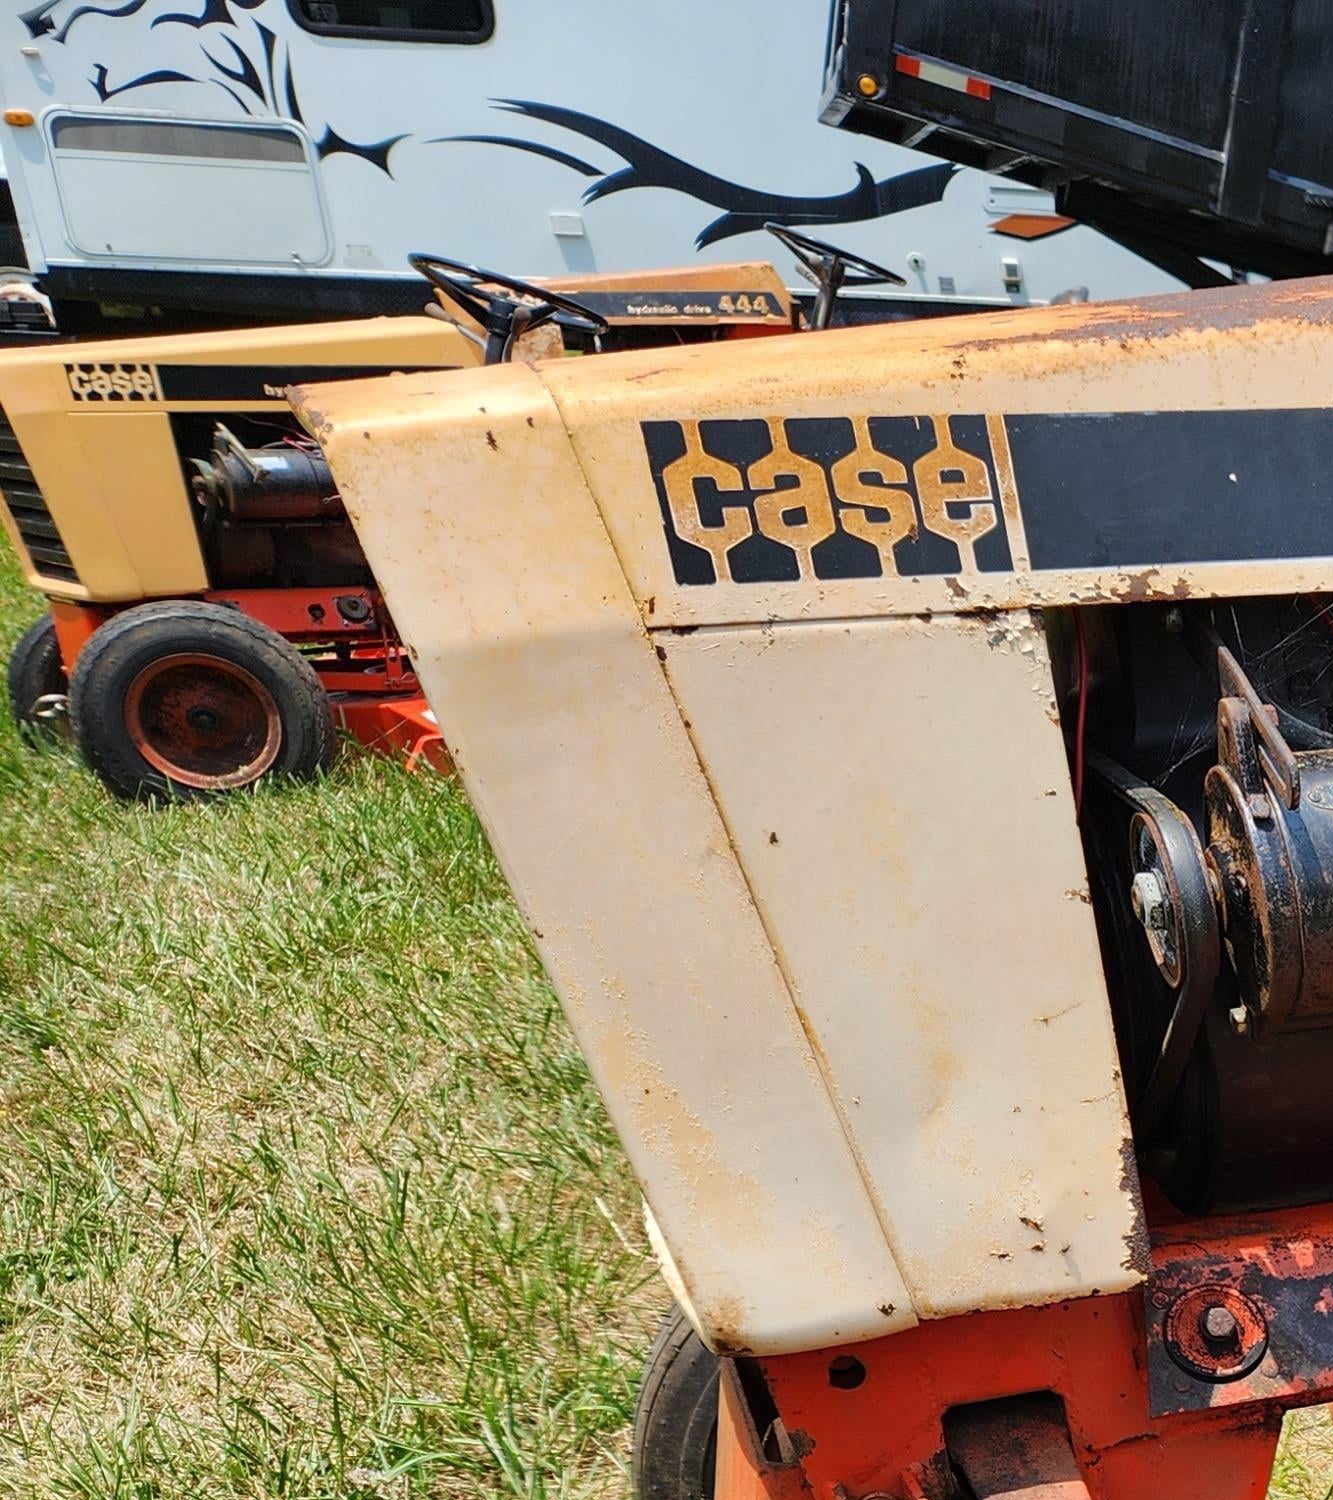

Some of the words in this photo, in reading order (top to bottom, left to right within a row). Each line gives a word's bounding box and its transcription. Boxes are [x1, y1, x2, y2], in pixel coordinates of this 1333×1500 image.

[719, 293, 770, 314] 444
[68, 365, 155, 398] case
[660, 424, 999, 576] case
